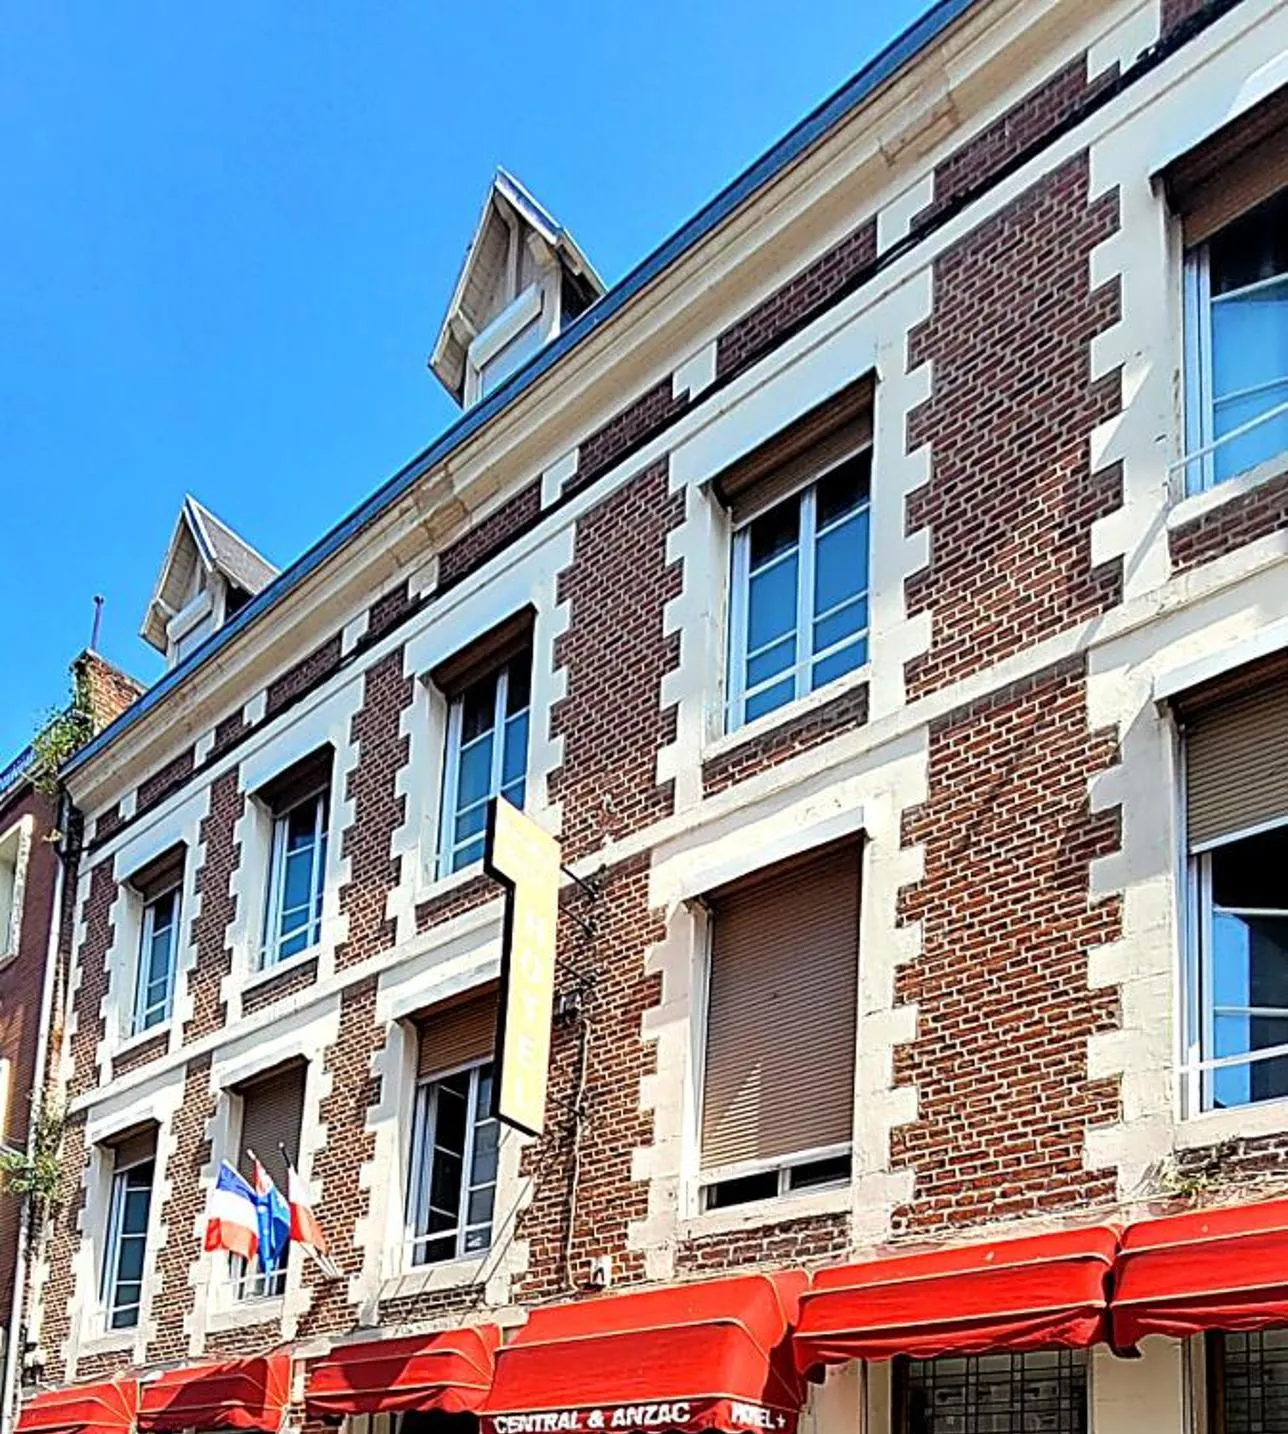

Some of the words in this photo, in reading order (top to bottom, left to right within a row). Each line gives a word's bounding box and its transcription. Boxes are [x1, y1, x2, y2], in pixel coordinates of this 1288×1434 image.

[493, 1410, 583, 1434] CENTRAL
[587, 1409, 605, 1429] &
[610, 1402, 691, 1428] ANZAC
